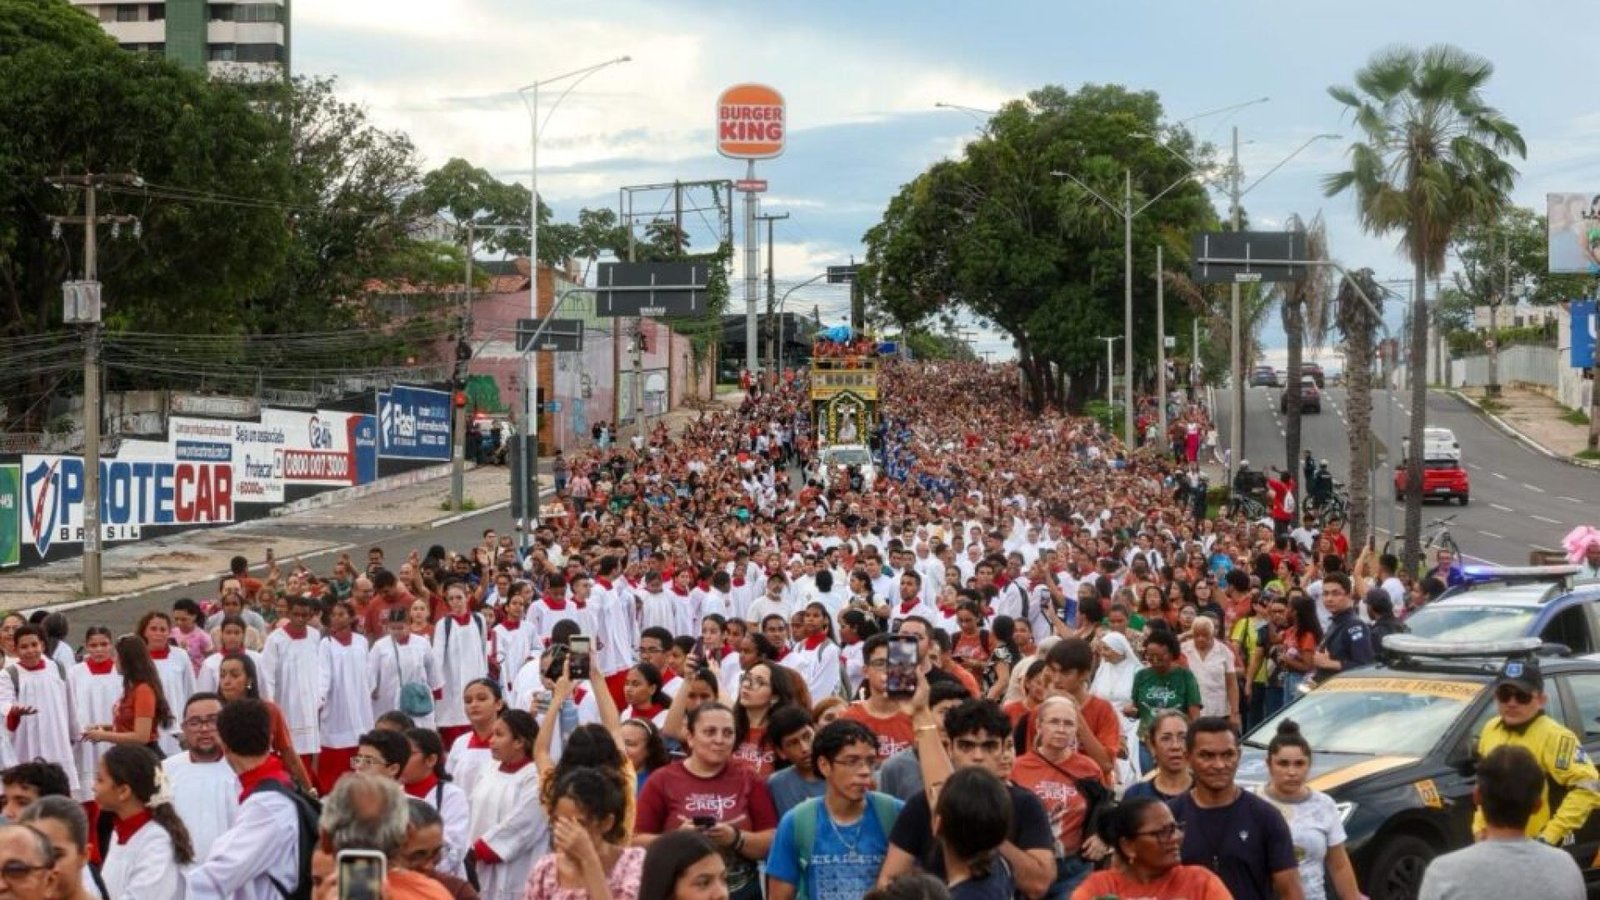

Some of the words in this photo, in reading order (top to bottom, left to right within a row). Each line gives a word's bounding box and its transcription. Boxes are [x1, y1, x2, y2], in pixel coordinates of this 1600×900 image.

[720, 106, 783, 120] BURGER
[720, 121, 783, 141] KING
[235, 425, 248, 444] Seja
[245, 454, 273, 477] Protecar
[285, 453, 308, 476] 0800
[310, 453, 326, 476] 007
[60, 526, 140, 540] BRSIL
